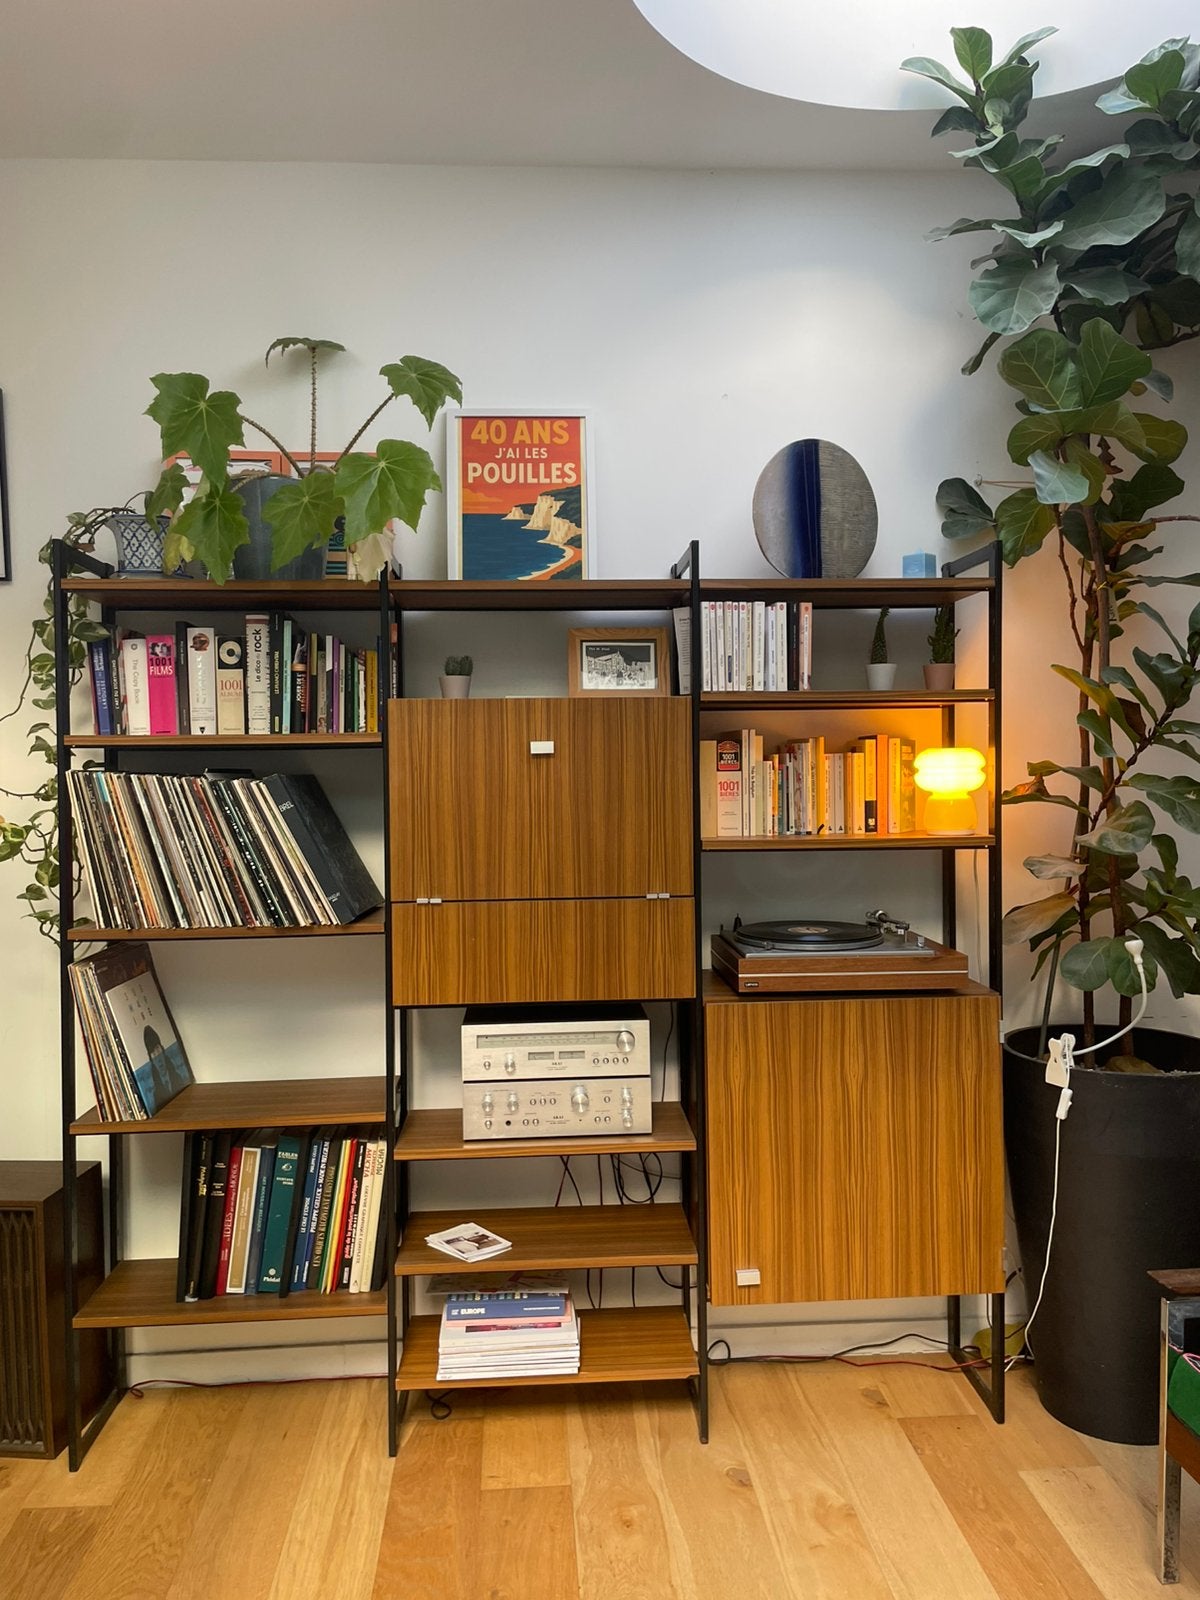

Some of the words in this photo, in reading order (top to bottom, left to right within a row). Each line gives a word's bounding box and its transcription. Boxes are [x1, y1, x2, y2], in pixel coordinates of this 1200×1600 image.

[470, 419, 507, 445] 40
[513, 419, 569, 445] ANS
[495, 447, 520, 459] J'AI
[525, 447, 548, 459] LES
[467, 462, 577, 484] POUILLES
[252, 628, 262, 652] rock
[149, 657, 172, 667] 1001
[149, 666, 173, 676] FILMS
[220, 679, 242, 691] 1001
[718, 781, 740, 791] 1001
[278, 800, 294, 812] BREL
[364, 1148, 372, 1177] MUCHA
[375, 1148, 385, 1175] MUCHA
[310, 1209, 319, 1233] PHILIPPE
[322, 1141, 330, 1162] BELGIUM
[347, 1206, 355, 1231] production
[460, 1307, 486, 1315] EUROPE
